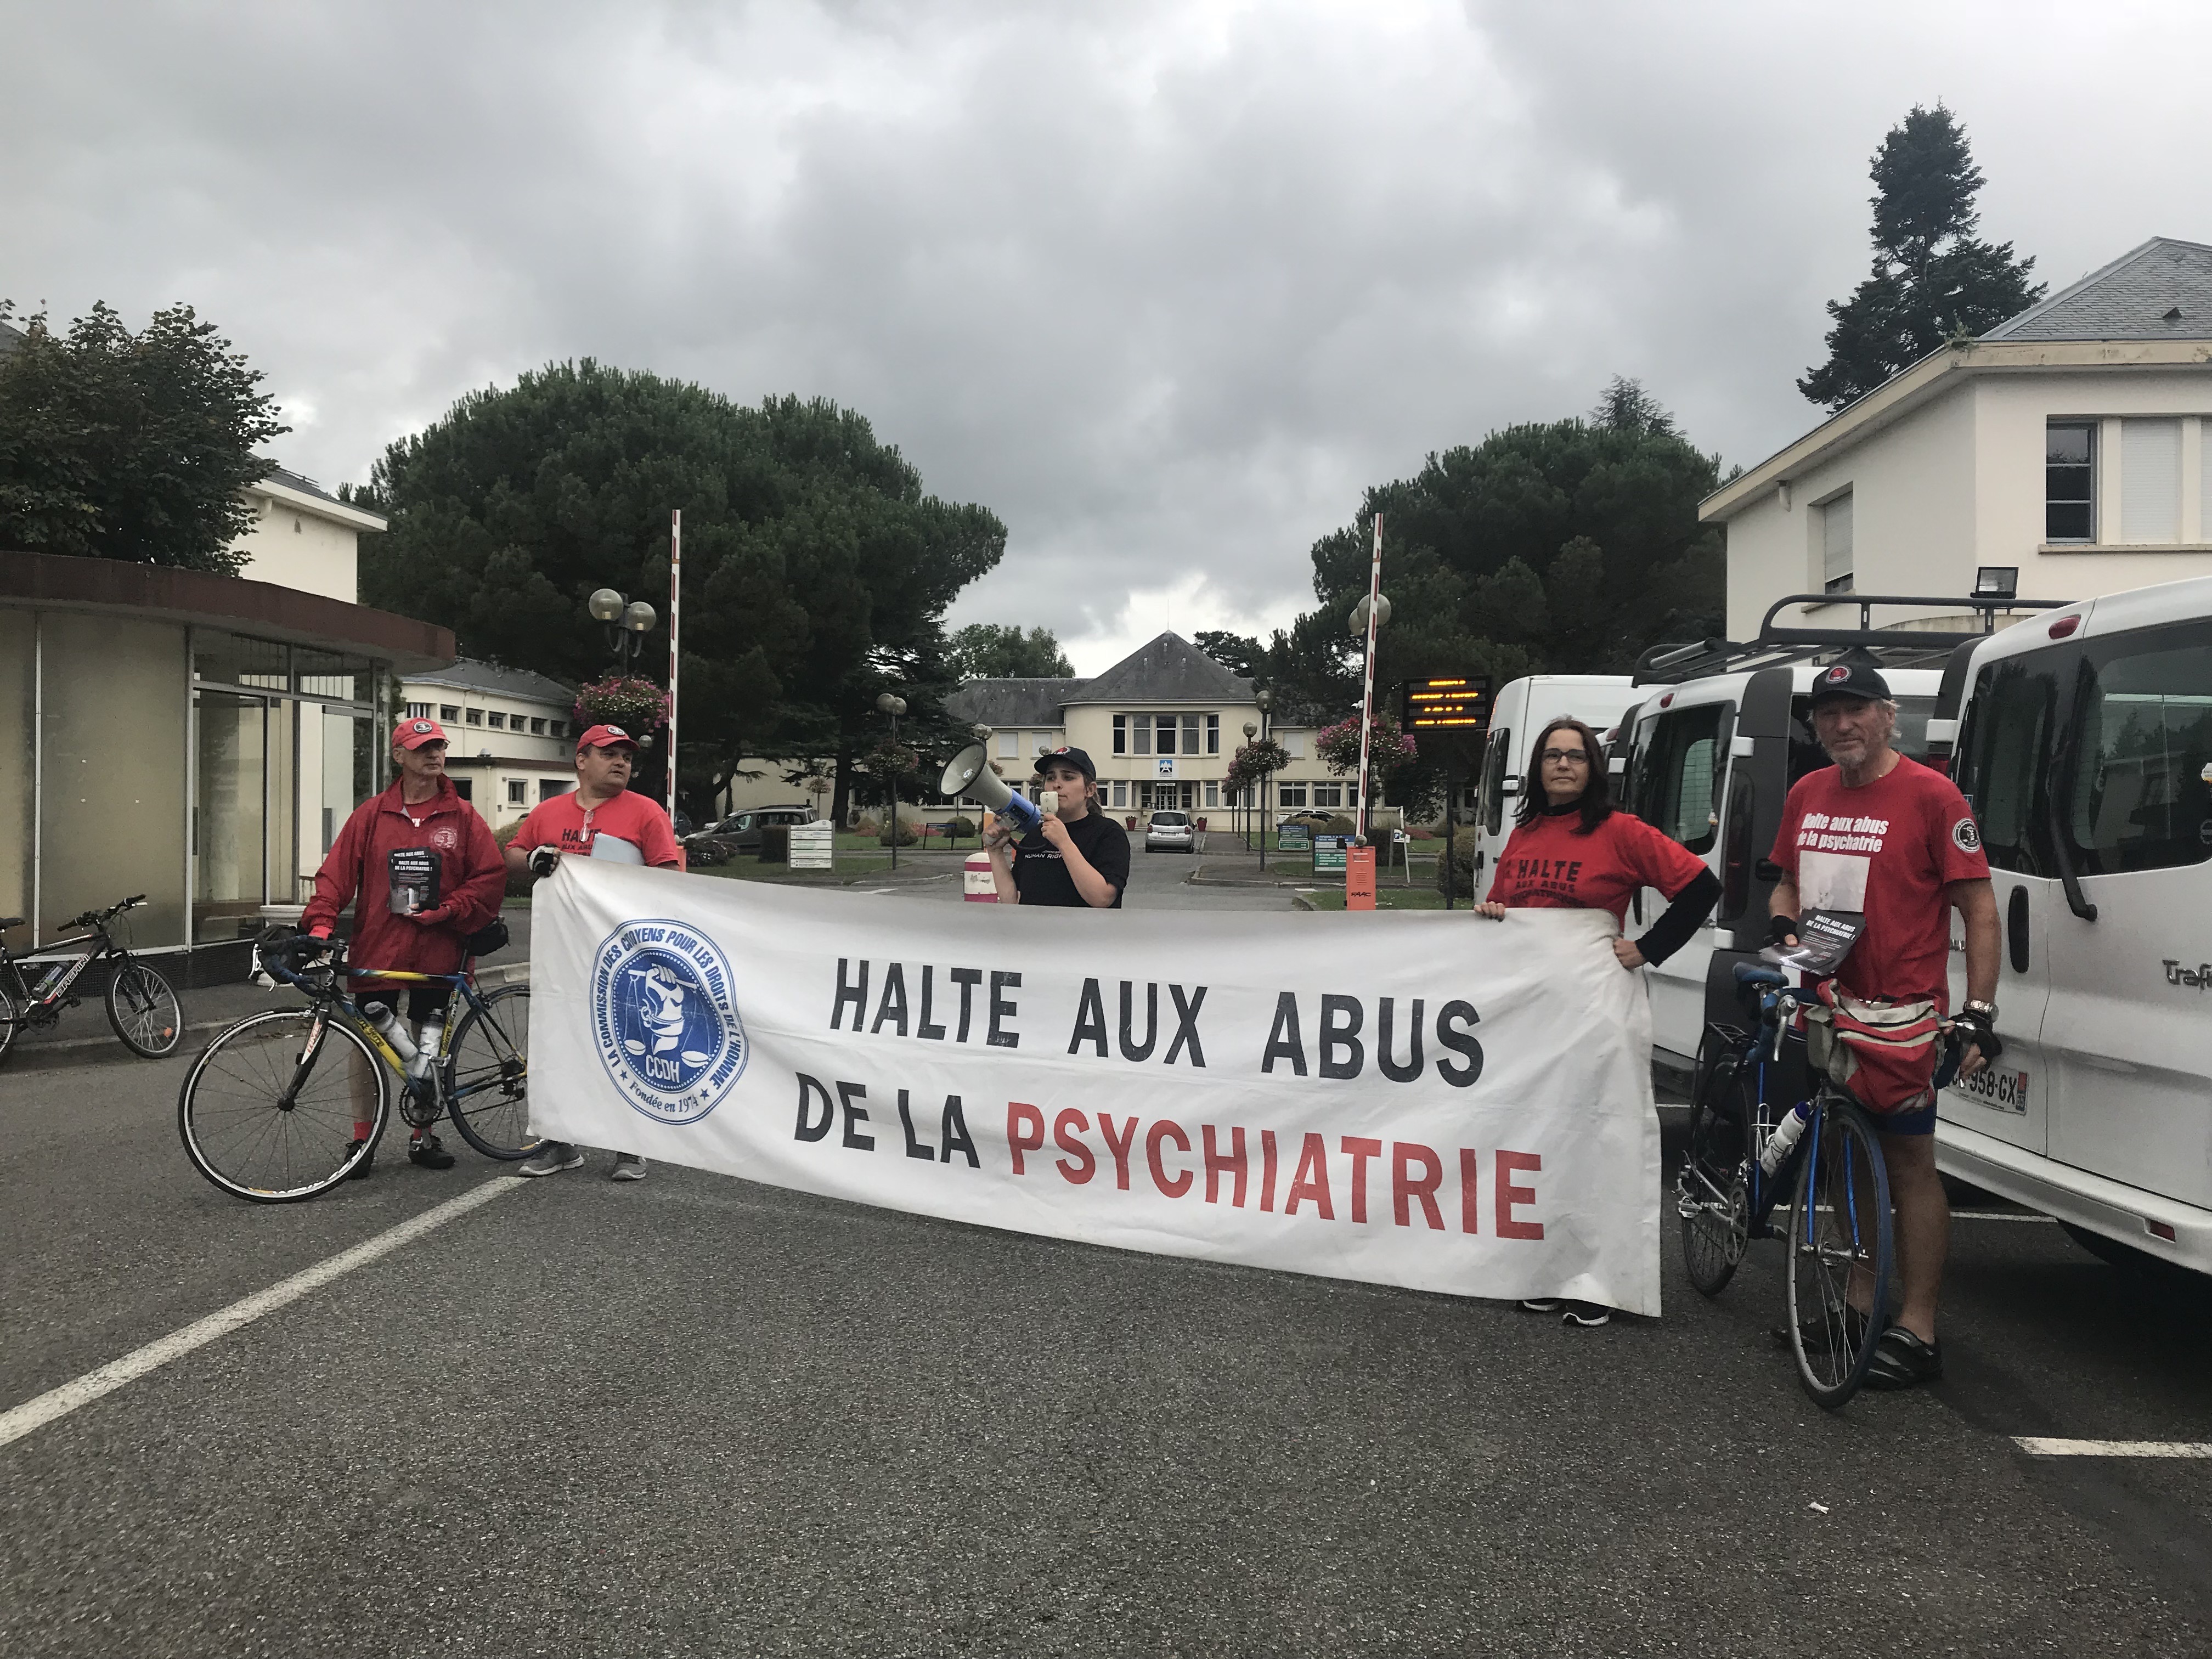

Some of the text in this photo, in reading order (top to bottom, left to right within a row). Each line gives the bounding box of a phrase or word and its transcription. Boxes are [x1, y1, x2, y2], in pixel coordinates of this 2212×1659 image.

[1829, 816, 1854, 832] aux
[1853, 816, 1889, 835] abus
[1806, 830, 1819, 847] la
[1517, 860, 1583, 882] HALTE
[665, 930, 697, 953] POUR
[602, 945, 622, 969] DES
[692, 946, 714, 969] LES
[704, 967, 729, 1011] DROITS
[596, 966, 613, 1048] COMMISSION
[723, 1014, 738, 1031] DE
[830, 958, 1485, 1088] HALTE AUX ABUS
[607, 1049, 622, 1068] LA
[645, 1054, 680, 1084] CCDH
[629, 1081, 663, 1110] Fondée
[664, 1102, 676, 1113] en
[794, 1071, 1545, 1240] DE LA PSYCHIATRIE
